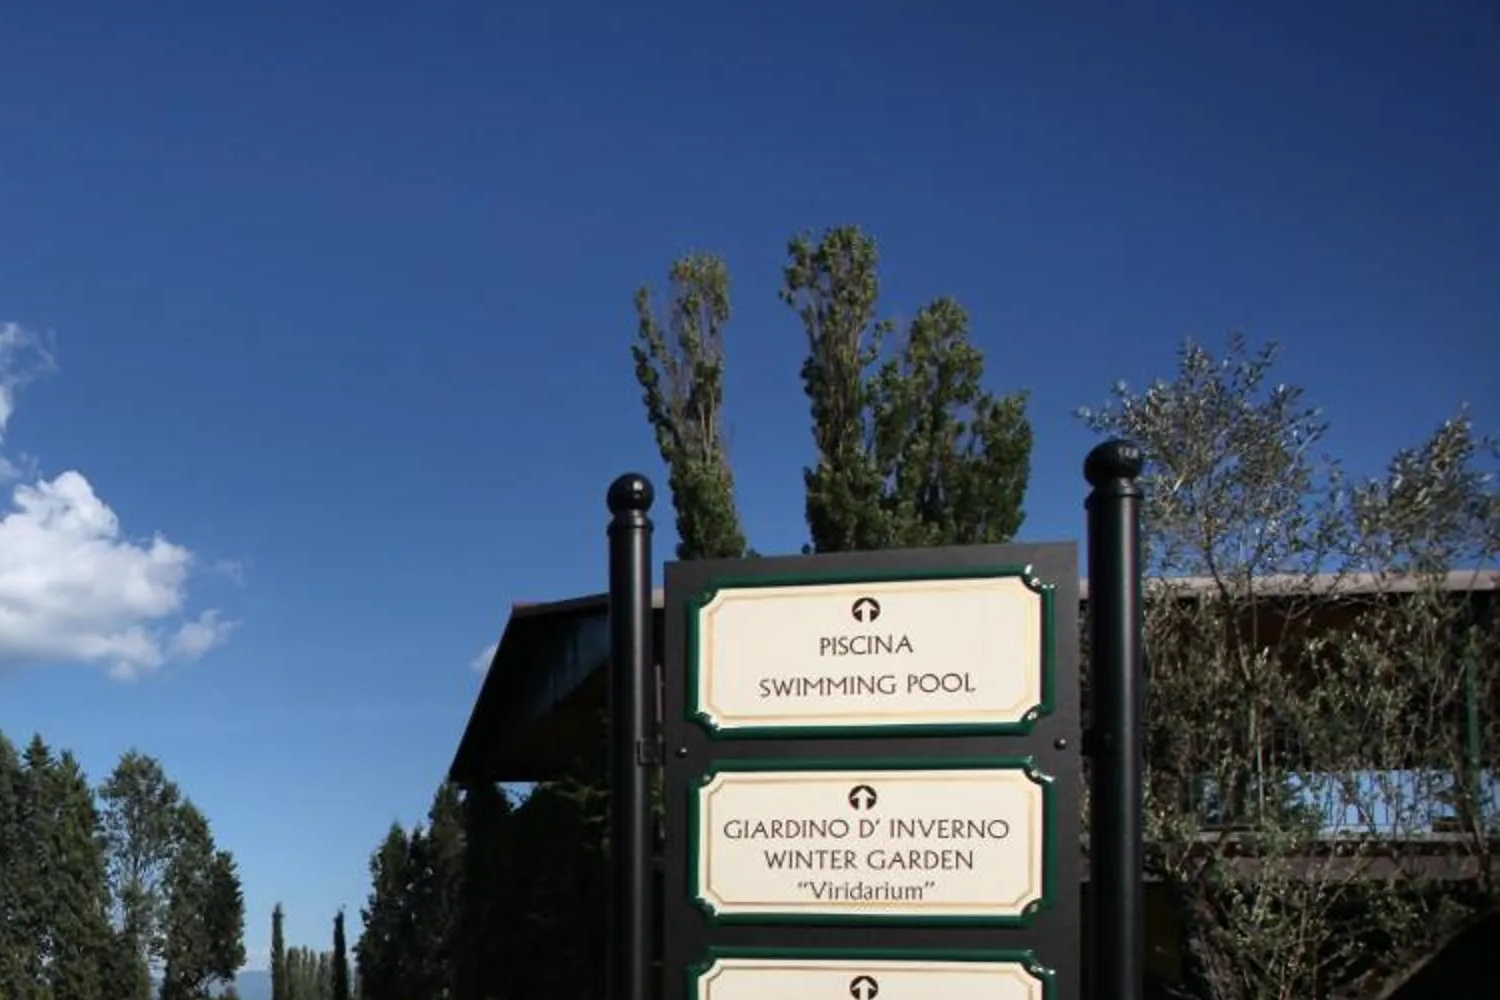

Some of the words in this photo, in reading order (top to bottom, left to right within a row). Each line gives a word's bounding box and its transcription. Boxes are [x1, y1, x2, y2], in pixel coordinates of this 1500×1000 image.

[820, 635, 914, 656] PISCINA
[759, 674, 896, 698] SWIMMING
[907, 672, 976, 694] POOL
[724, 819, 850, 840] GIARDINO
[764, 850, 857, 870] WINTER
[867, 850, 974, 870] GARDEN
[798, 881, 936, 901] "Viridarium"
